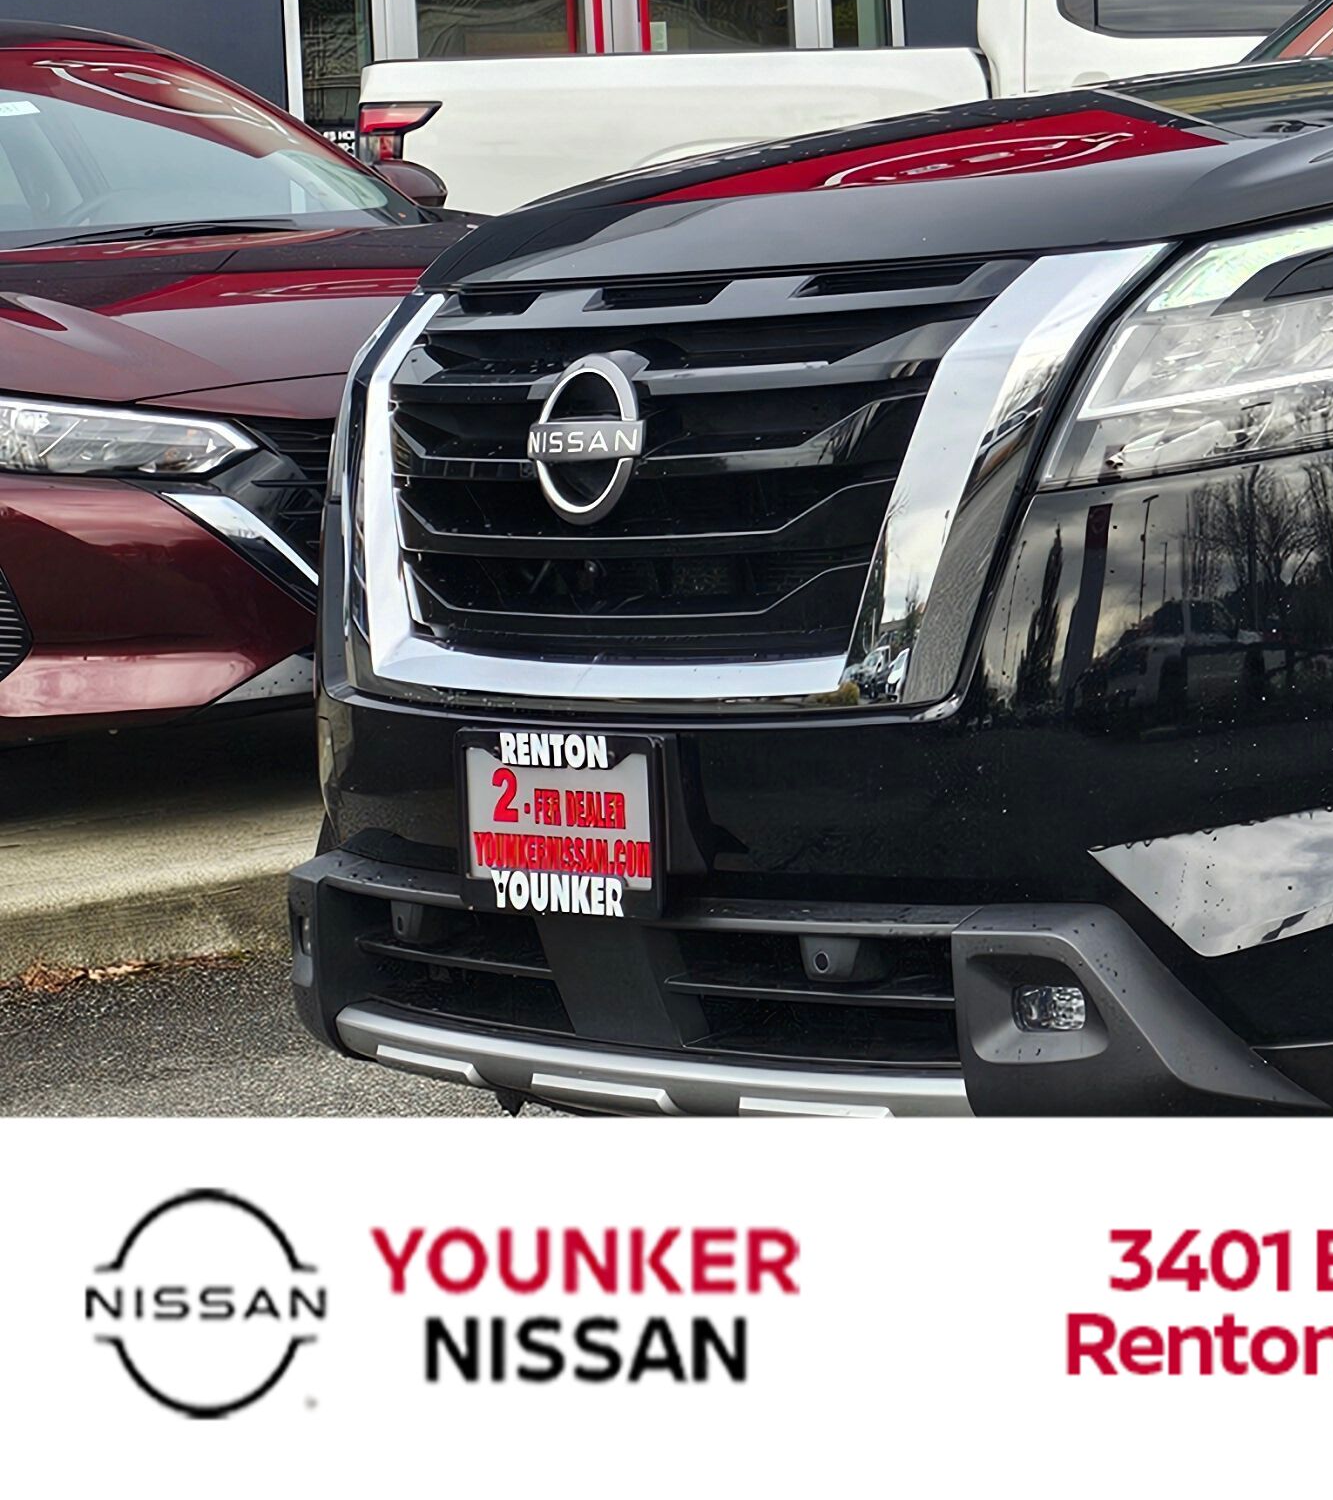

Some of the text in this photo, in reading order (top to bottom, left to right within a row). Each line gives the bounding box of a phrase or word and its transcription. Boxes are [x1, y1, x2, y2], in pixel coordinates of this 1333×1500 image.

[528, 429, 638, 454] NISSAN
[499, 732, 608, 769] RENTON
[565, 790, 626, 830] DEALER
[473, 831, 651, 878] YOUNKERNISSAN.COM
[490, 869, 624, 917] YOUNKER
